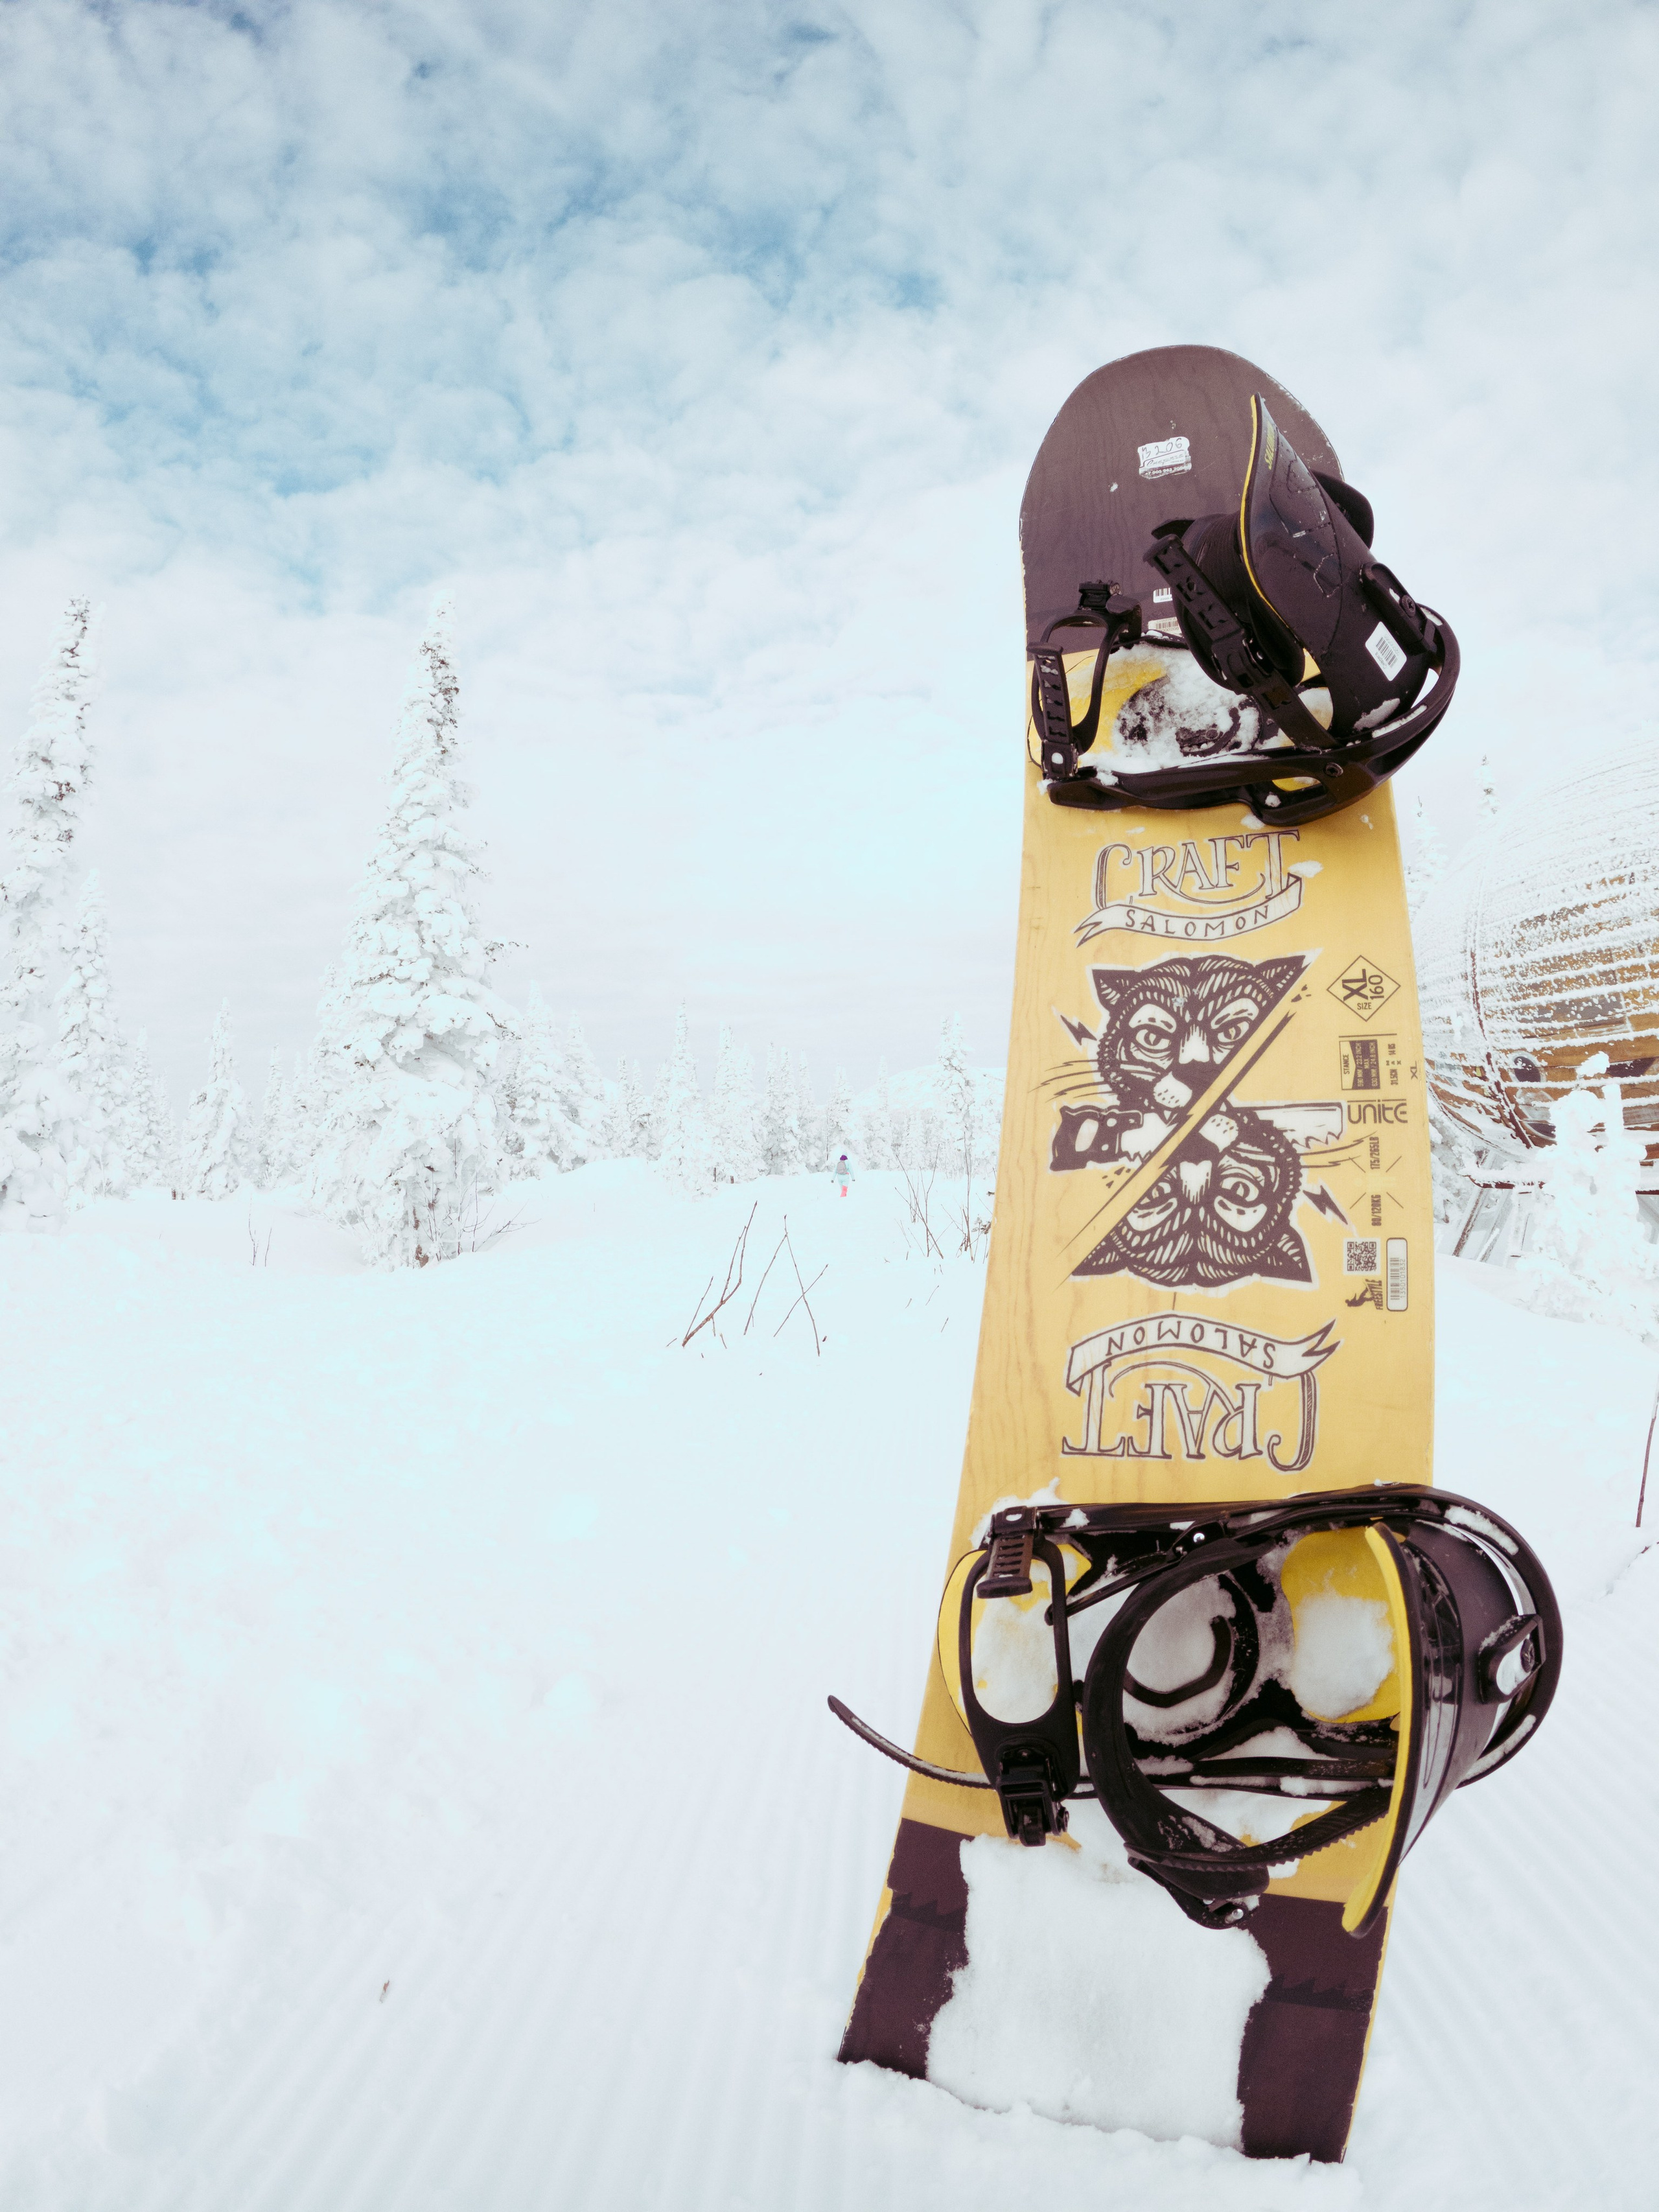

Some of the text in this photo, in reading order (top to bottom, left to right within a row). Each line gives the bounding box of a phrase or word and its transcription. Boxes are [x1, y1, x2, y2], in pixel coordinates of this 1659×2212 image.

[1095, 829, 1300, 909] CRAFT
[1124, 904, 1270, 938] SALOMON
[1341, 968, 1369, 1001] XL
[1367, 974, 1385, 1000] 160
[1356, 1002, 1372, 1010] SIZE
[1357, 1069, 1362, 1077] MM
[1371, 1068, 1376, 1077] MM
[1410, 1060, 1418, 1080] XL
[1369, 1136, 1380, 1170] 175/265LB
[1371, 1194, 1382, 1226] 80/120KG
[1365, 1279, 1383, 1310] FREESTYLE
[1105, 1318, 1276, 1369] SALOMON
[1061, 1360, 1317, 1471] CRAFT
